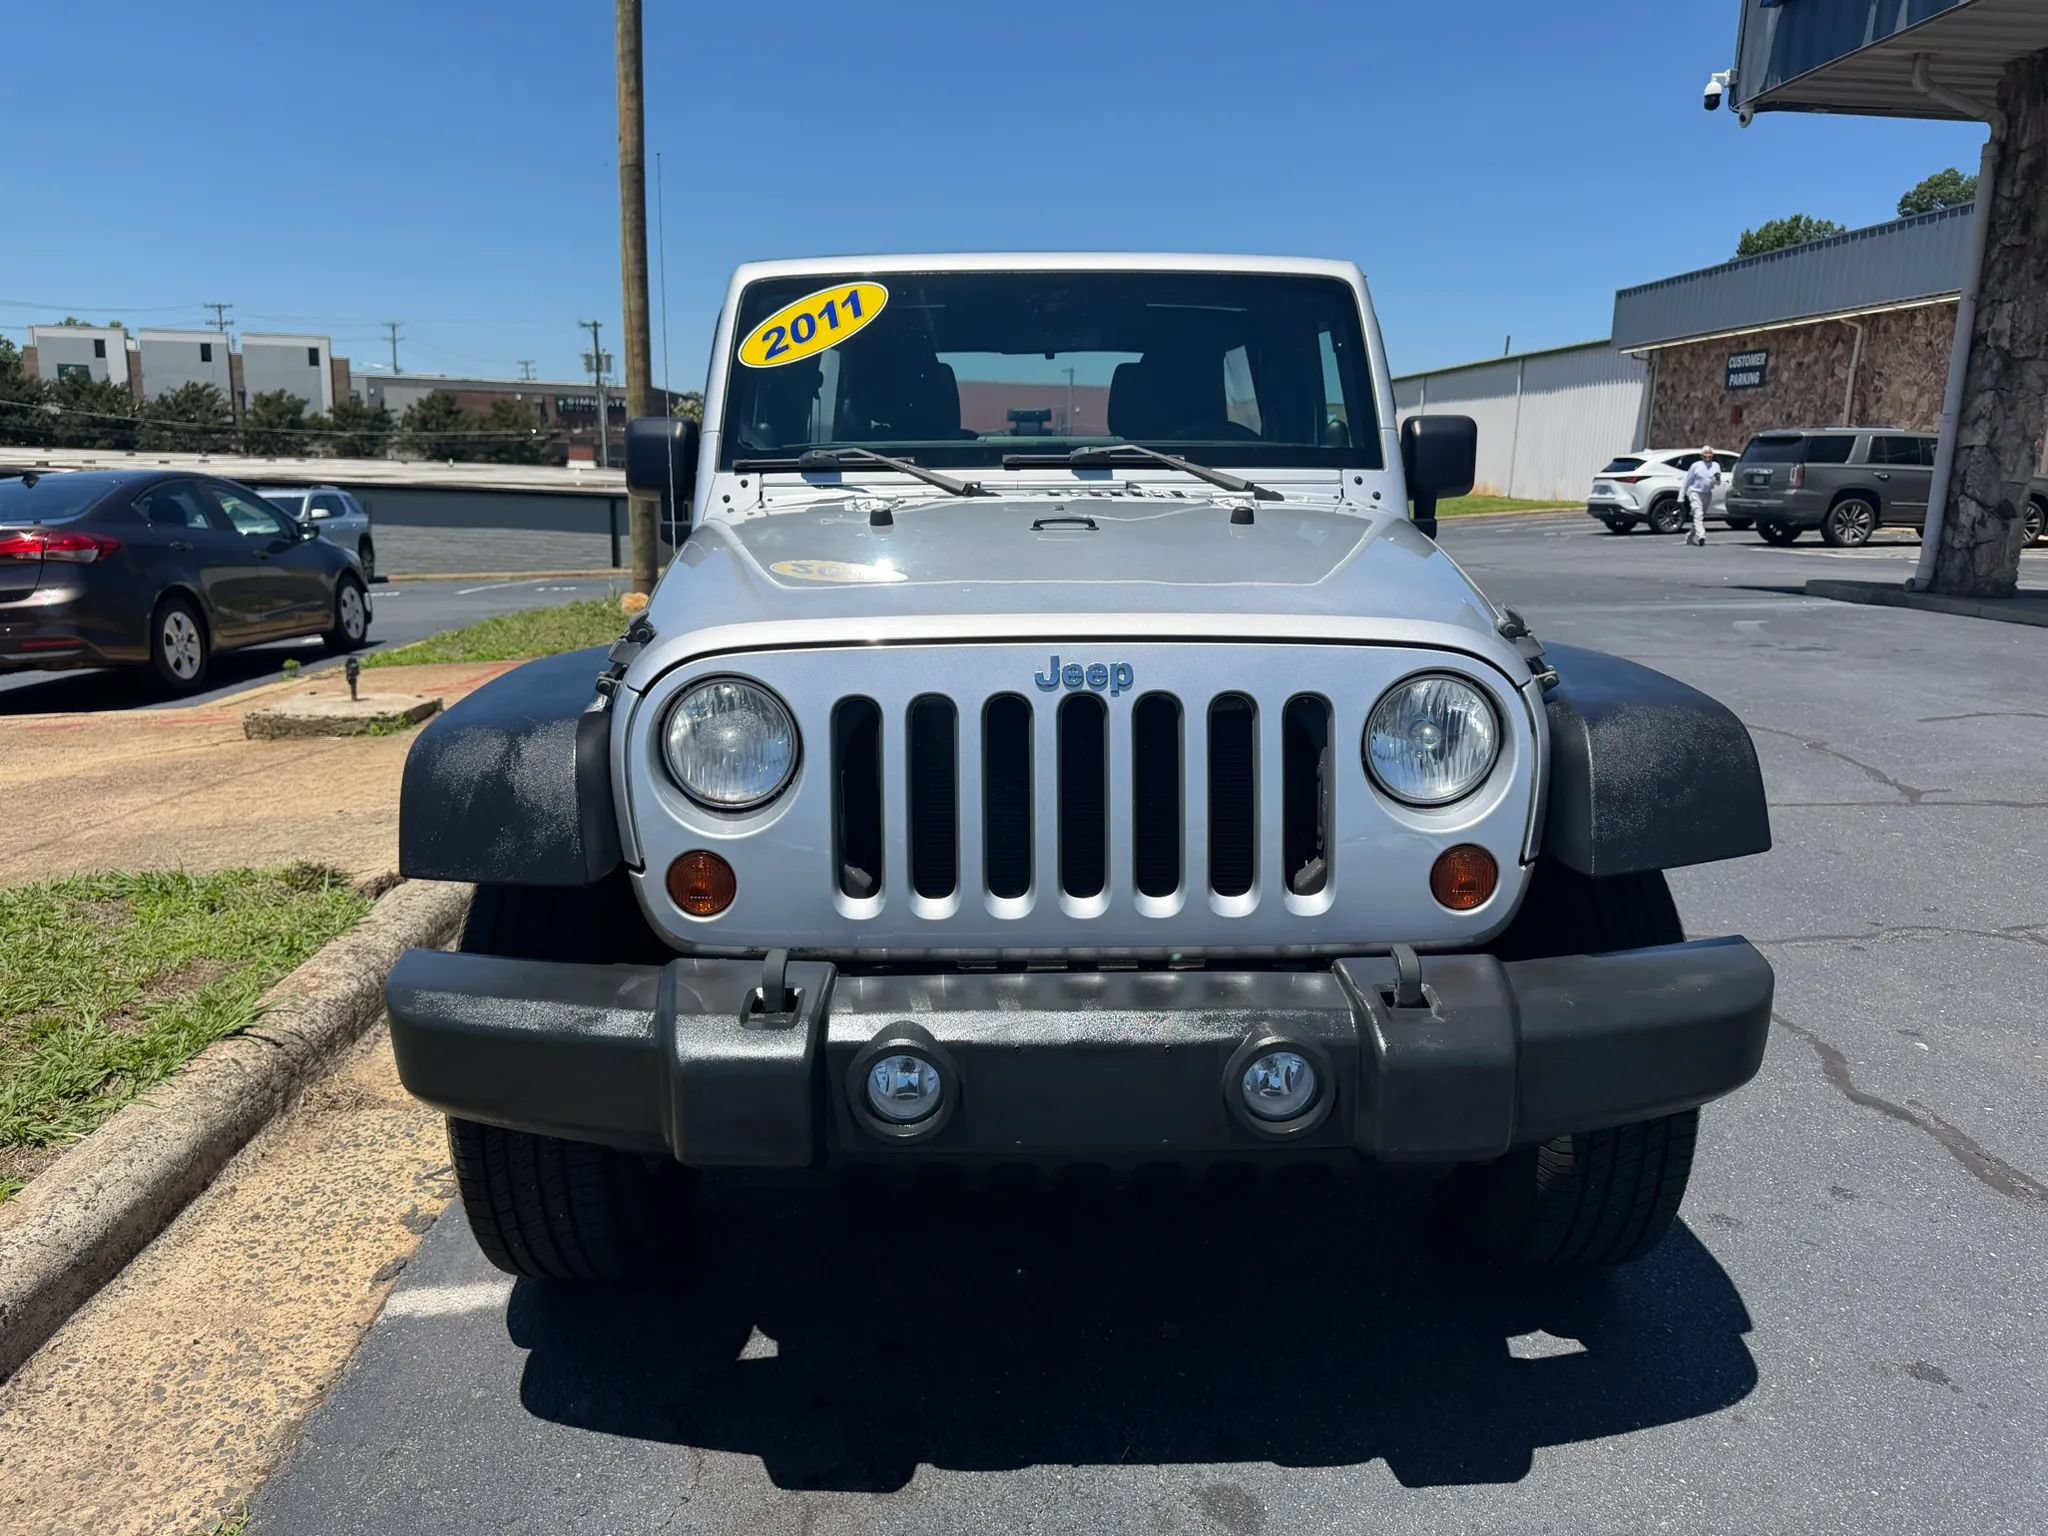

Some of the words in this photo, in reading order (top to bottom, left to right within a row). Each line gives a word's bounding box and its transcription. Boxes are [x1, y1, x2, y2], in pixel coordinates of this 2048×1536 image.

[762, 289, 863, 361] 2011
[1728, 352, 1767, 369] CUSTOMER
[1728, 371, 1761, 387] PARKING
[1034, 655, 1134, 697] Jeep
